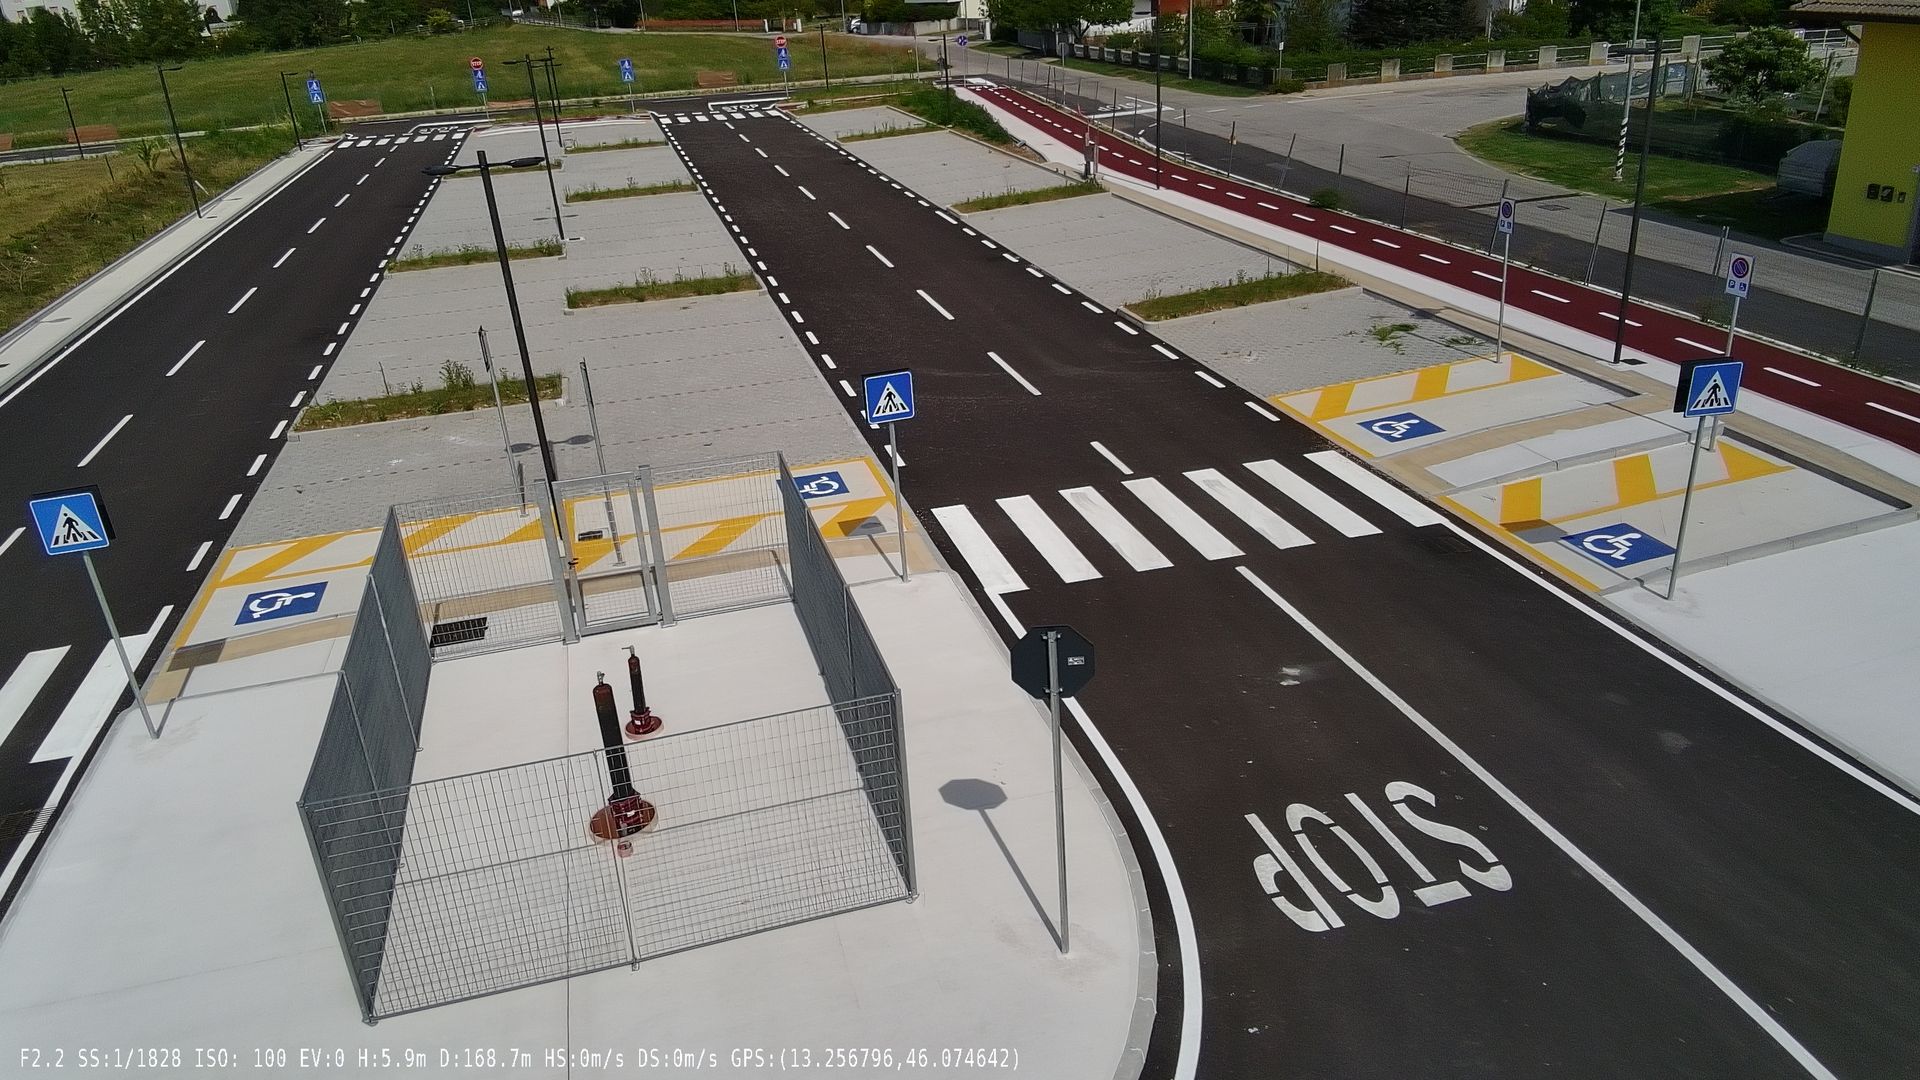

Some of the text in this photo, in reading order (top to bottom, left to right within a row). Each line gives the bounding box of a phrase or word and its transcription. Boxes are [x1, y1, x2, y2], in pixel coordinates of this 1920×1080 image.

[721, 103, 759, 113] STOP
[1097, 102, 1142, 112] STOP
[418, 125, 459, 135] STOP
[1244, 781, 1513, 932] STOP
